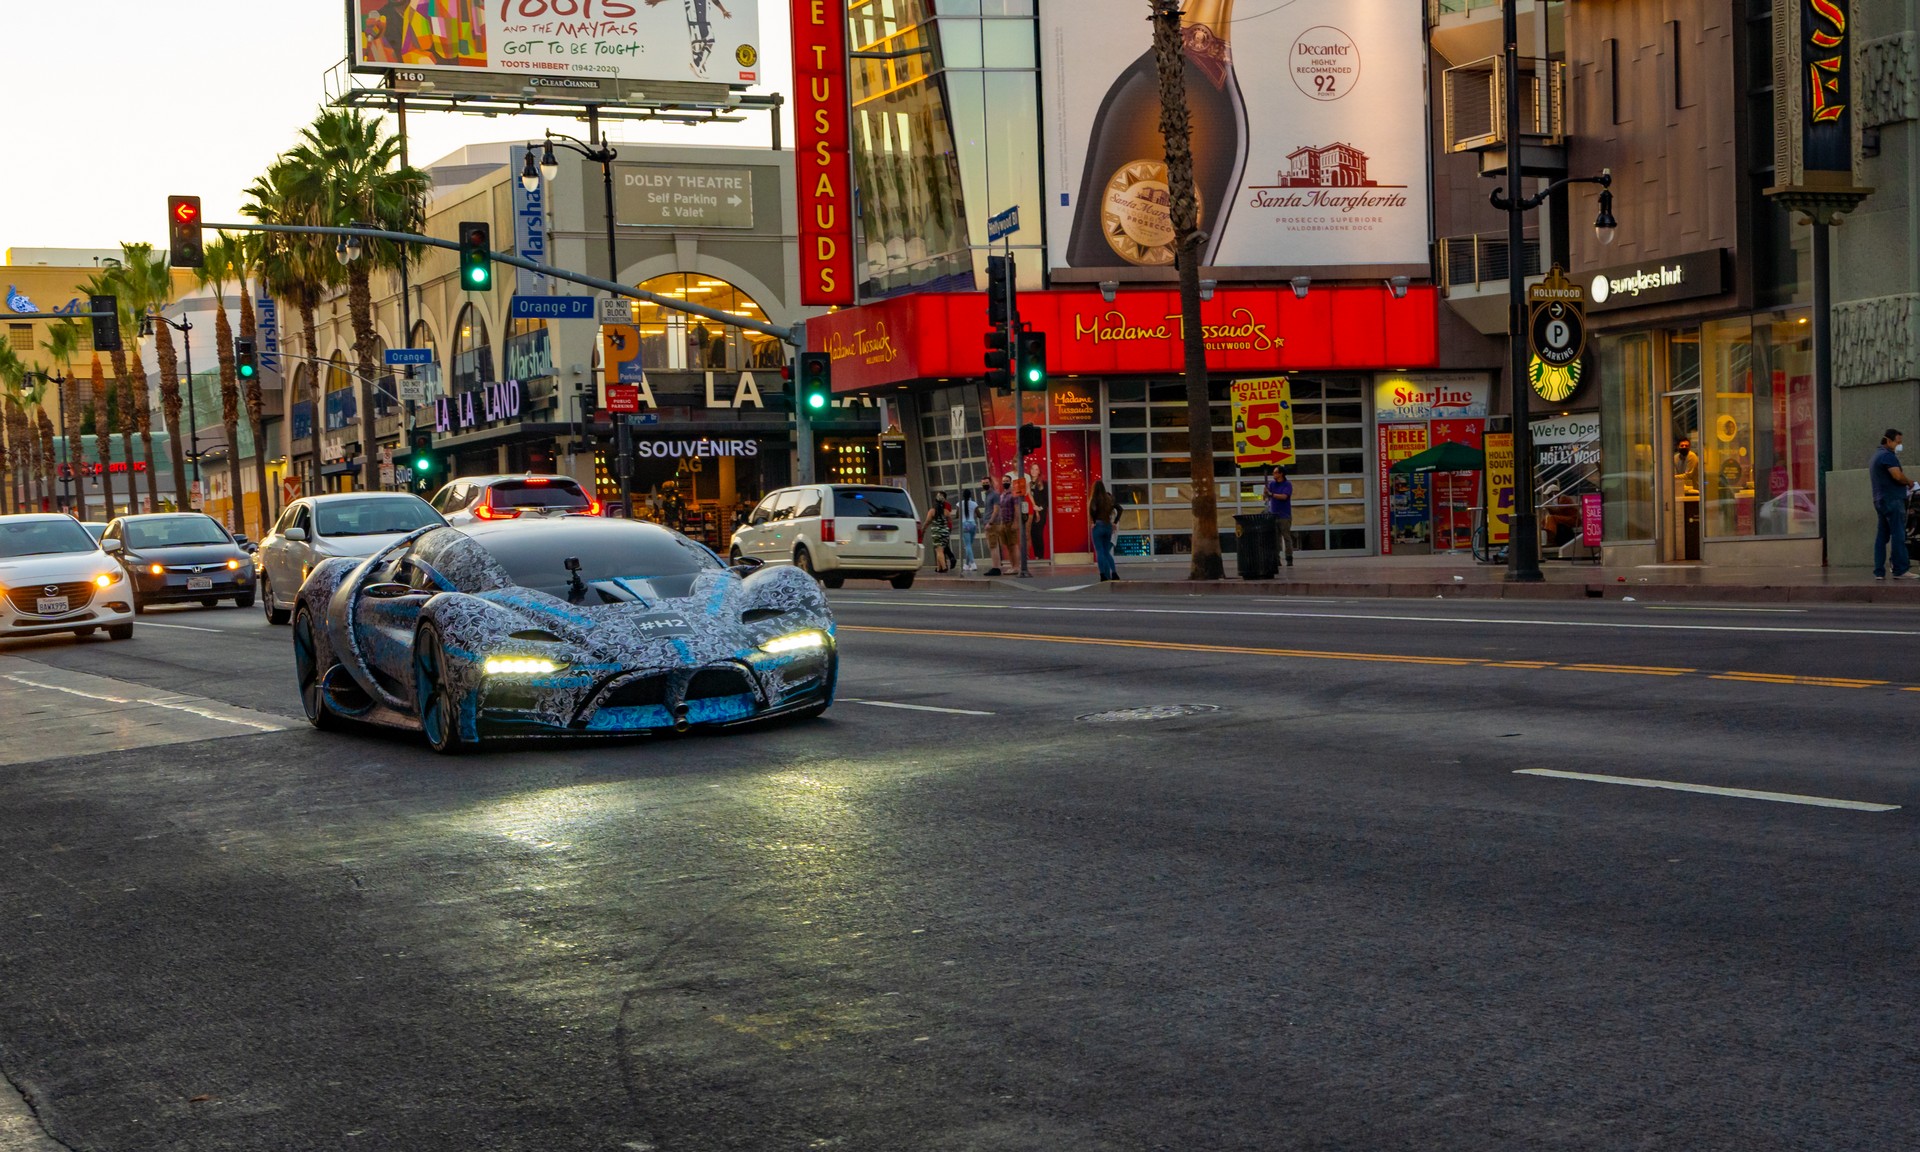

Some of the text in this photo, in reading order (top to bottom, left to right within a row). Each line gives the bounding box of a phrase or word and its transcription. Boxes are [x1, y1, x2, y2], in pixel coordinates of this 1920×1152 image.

[503, 21, 638, 39] AND THE MAYTALS
[503, 40, 645, 57] GOT TO BE TOUGH:
[1298, 43, 1350, 55] Decanter
[500, 60, 620, 74] TOOTS HIBBERT (1942-2020)
[396, 72, 424, 81] 1160
[1314, 75, 1335, 91] 92
[811, 46, 836, 293] TUSSAUDS
[625, 174, 742, 189] DOLBY THEATRE
[647, 192, 717, 206] Self Parking
[1250, 190, 1407, 213] Santa Margherita
[662, 206, 704, 217] & Valet
[1127, 215, 1171, 233] PROSECCO
[1610, 265, 1682, 296] sunglass hut
[1534, 289, 1580, 298] HOLLYWOOD
[520, 301, 587, 315] Orange Dr
[1076, 308, 1271, 350] Madame Tssauds
[1554, 325, 1563, 343] P
[1203, 342, 1251, 350] OLLYWOOD
[392, 353, 424, 362] Orange
[1542, 347, 1574, 360] PARKING
[620, 373, 641, 381] Parking
[706, 372, 764, 408] LA
[1232, 380, 1285, 392] HOLIDAY
[1054, 391, 1094, 404] Madame
[1239, 390, 1281, 401] SALE!
[1393, 386, 1473, 408] StarLine
[435, 398, 450, 433] LA
[459, 391, 475, 427] LA
[484, 380, 519, 422] LAND
[1054, 403, 1094, 414] Tussauds
[1389, 431, 1426, 443] FREE
[1533, 424, 1566, 437] We're
[638, 440, 758, 459] SOUVENIRS
[677, 456, 702, 472] AG
[1586, 508, 1601, 517] SALE
[639, 619, 687, 631] #H2
